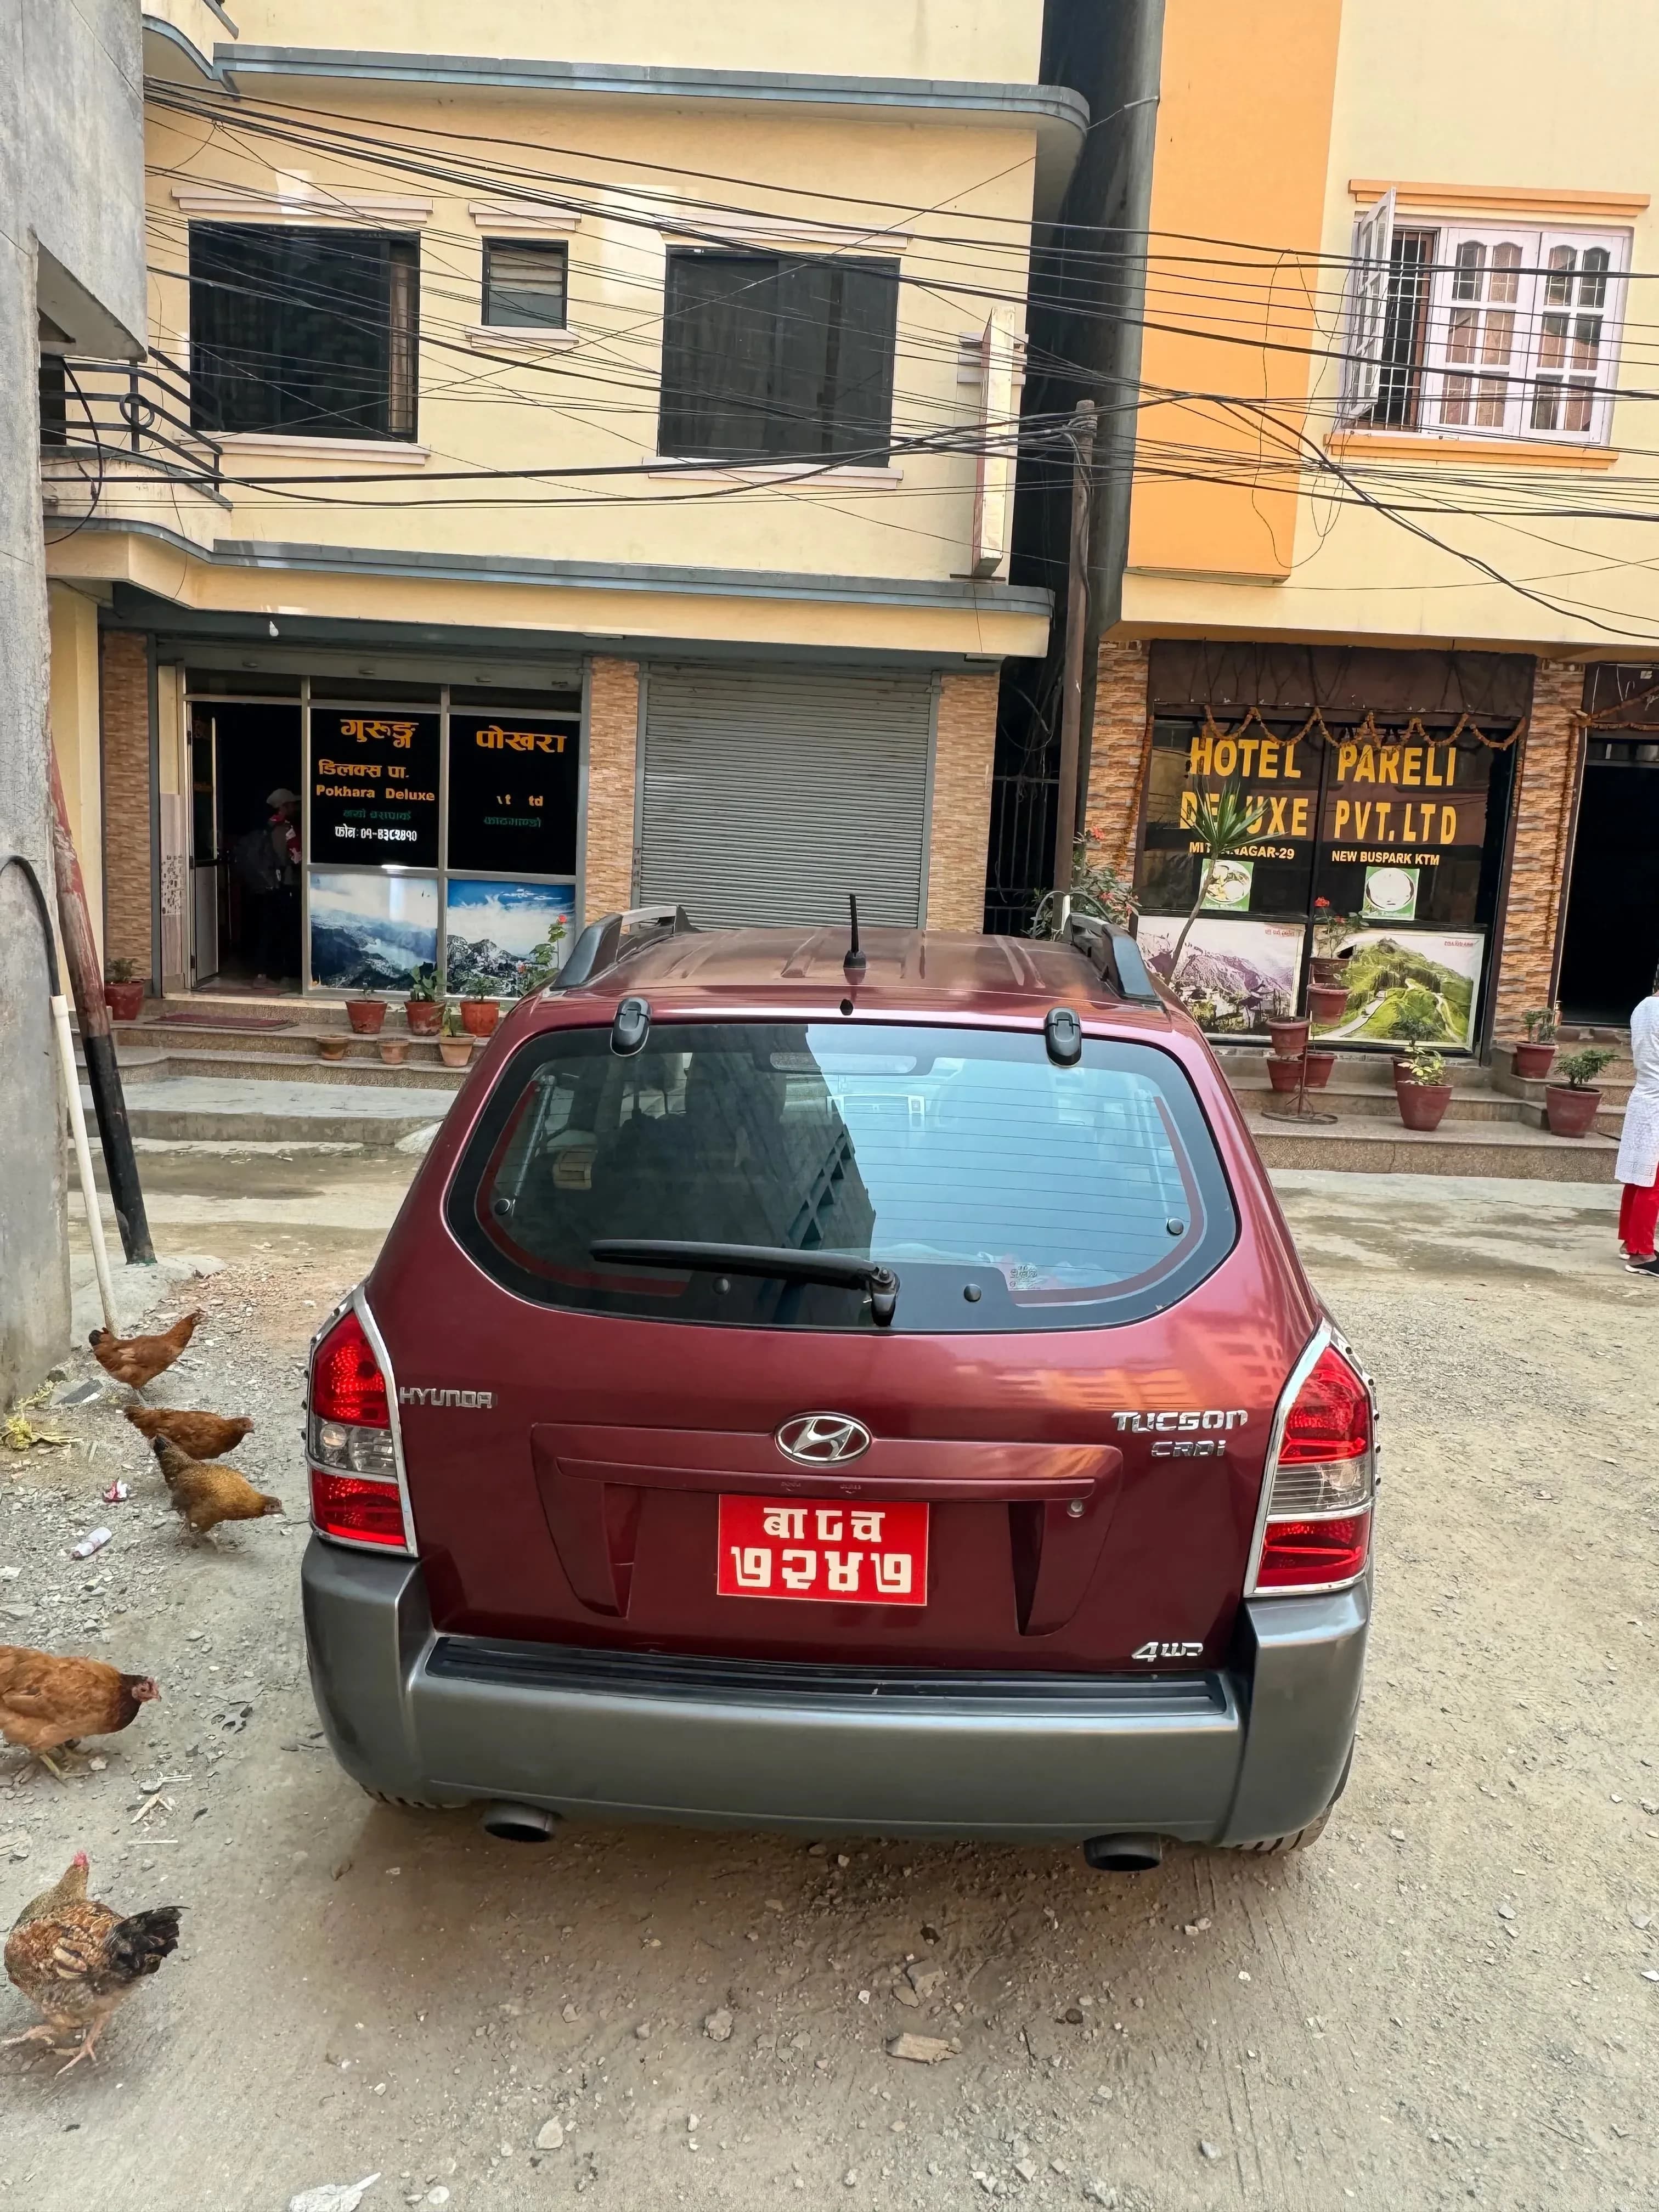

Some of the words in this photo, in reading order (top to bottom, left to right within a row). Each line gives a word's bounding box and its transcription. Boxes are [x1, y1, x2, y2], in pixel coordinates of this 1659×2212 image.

[476, 725, 568, 753] पोखरा
[319, 759, 382, 777] डिलक्स
[1190, 737, 1301, 778] HOTEL
[1337, 742, 1457, 786] PARELI
[317, 785, 375, 798] Pokhara
[385, 788, 435, 801] Deluxe
[1332, 850, 1357, 862] NEW
[1360, 852, 1412, 864] BUSPARK
[1415, 854, 1440, 866] KTM
[731, 1546, 912, 1593] ७२४७
[1131, 1642, 1203, 1662] 4WD
